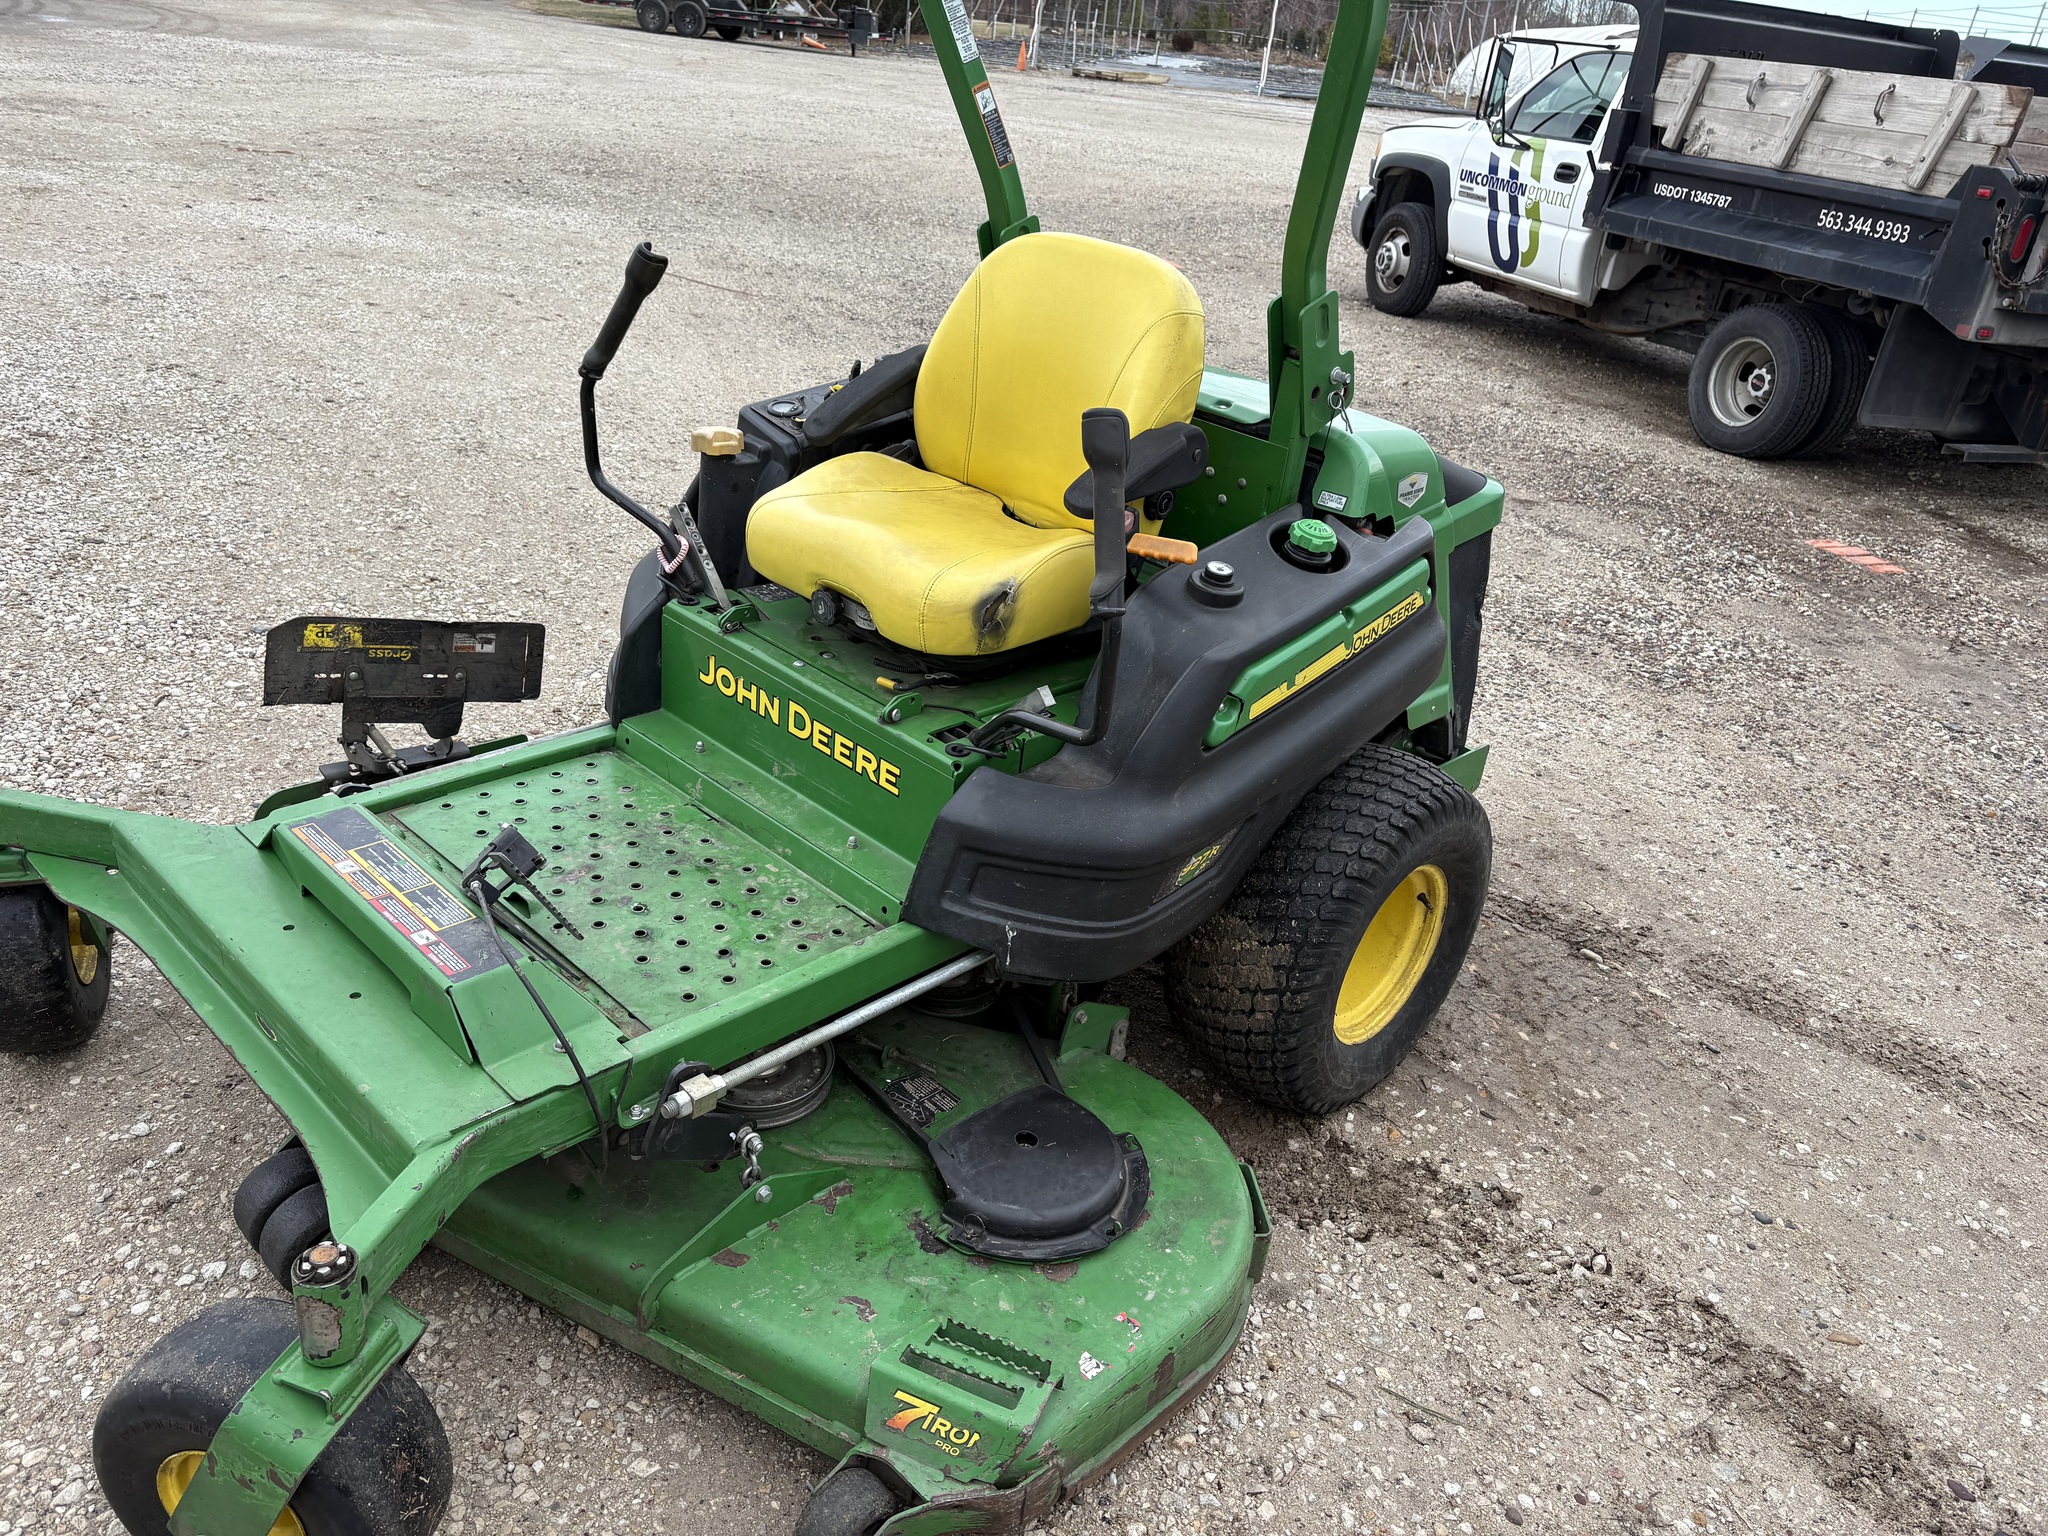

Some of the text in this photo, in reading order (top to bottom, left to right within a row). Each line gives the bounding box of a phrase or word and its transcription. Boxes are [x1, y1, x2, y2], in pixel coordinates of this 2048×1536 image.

[1460, 168, 1527, 197] UNCOMMON
[1525, 184, 1576, 209] ground
[1653, 182, 1733, 209] USDOT 1345787
[1817, 208, 1911, 244] 563.344.9393
[1345, 596, 1418, 658] JOHN DEERE
[368, 649, 412, 661] Grass
[699, 654, 902, 798] JOHN DEERE
[885, 1388, 942, 1434] 7
[934, 1439, 960, 1456] PRO
